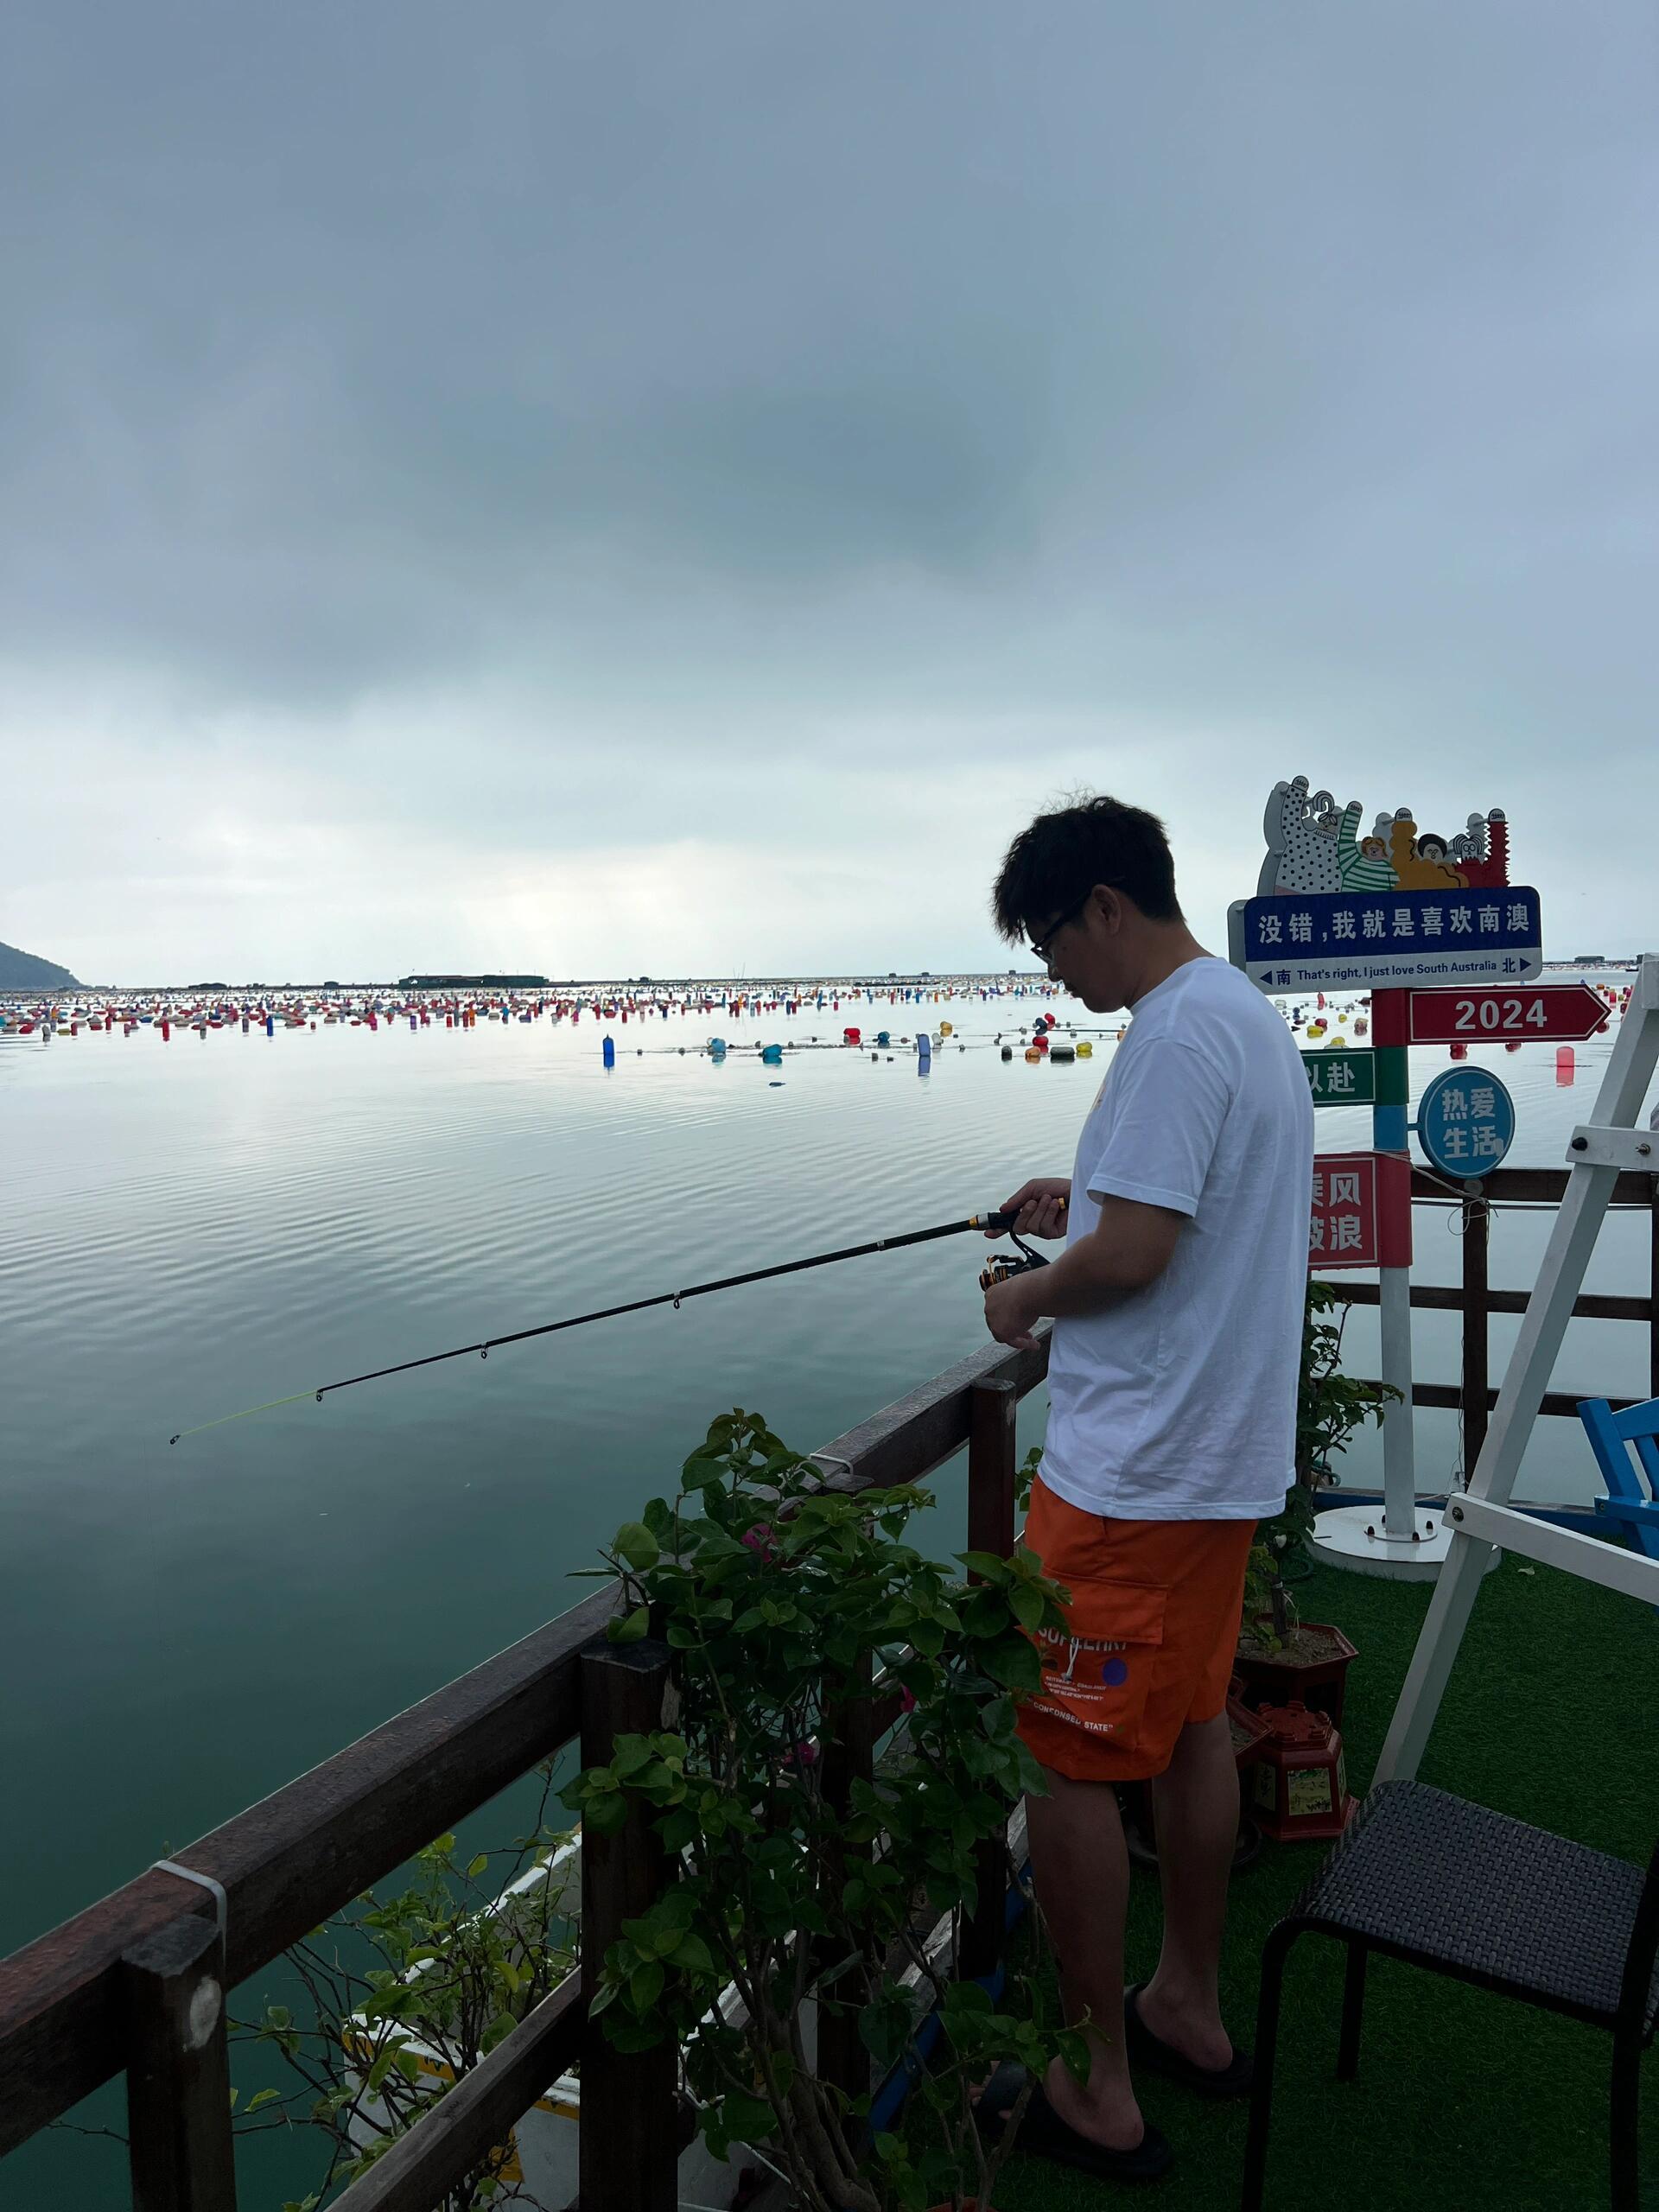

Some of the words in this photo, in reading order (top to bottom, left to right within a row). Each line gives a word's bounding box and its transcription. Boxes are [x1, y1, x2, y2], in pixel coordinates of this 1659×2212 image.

[1258, 903, 1529, 944] 没错,我就是喜欢南澳
[1276, 969, 1291, 985] 南
[1297, 969, 1331, 980] That's
[1332, 967, 1362, 979] right,
[1369, 966, 1389, 978] just
[1392, 965, 1414, 976] love
[1417, 963, 1448, 974] South
[1451, 961, 1497, 972] Australia
[1502, 957, 1516, 974] 北
[1455, 999, 1547, 1030] 2024
[1441, 1086, 1495, 1121] 热爱
[1443, 1125, 1504, 1159] 生活
